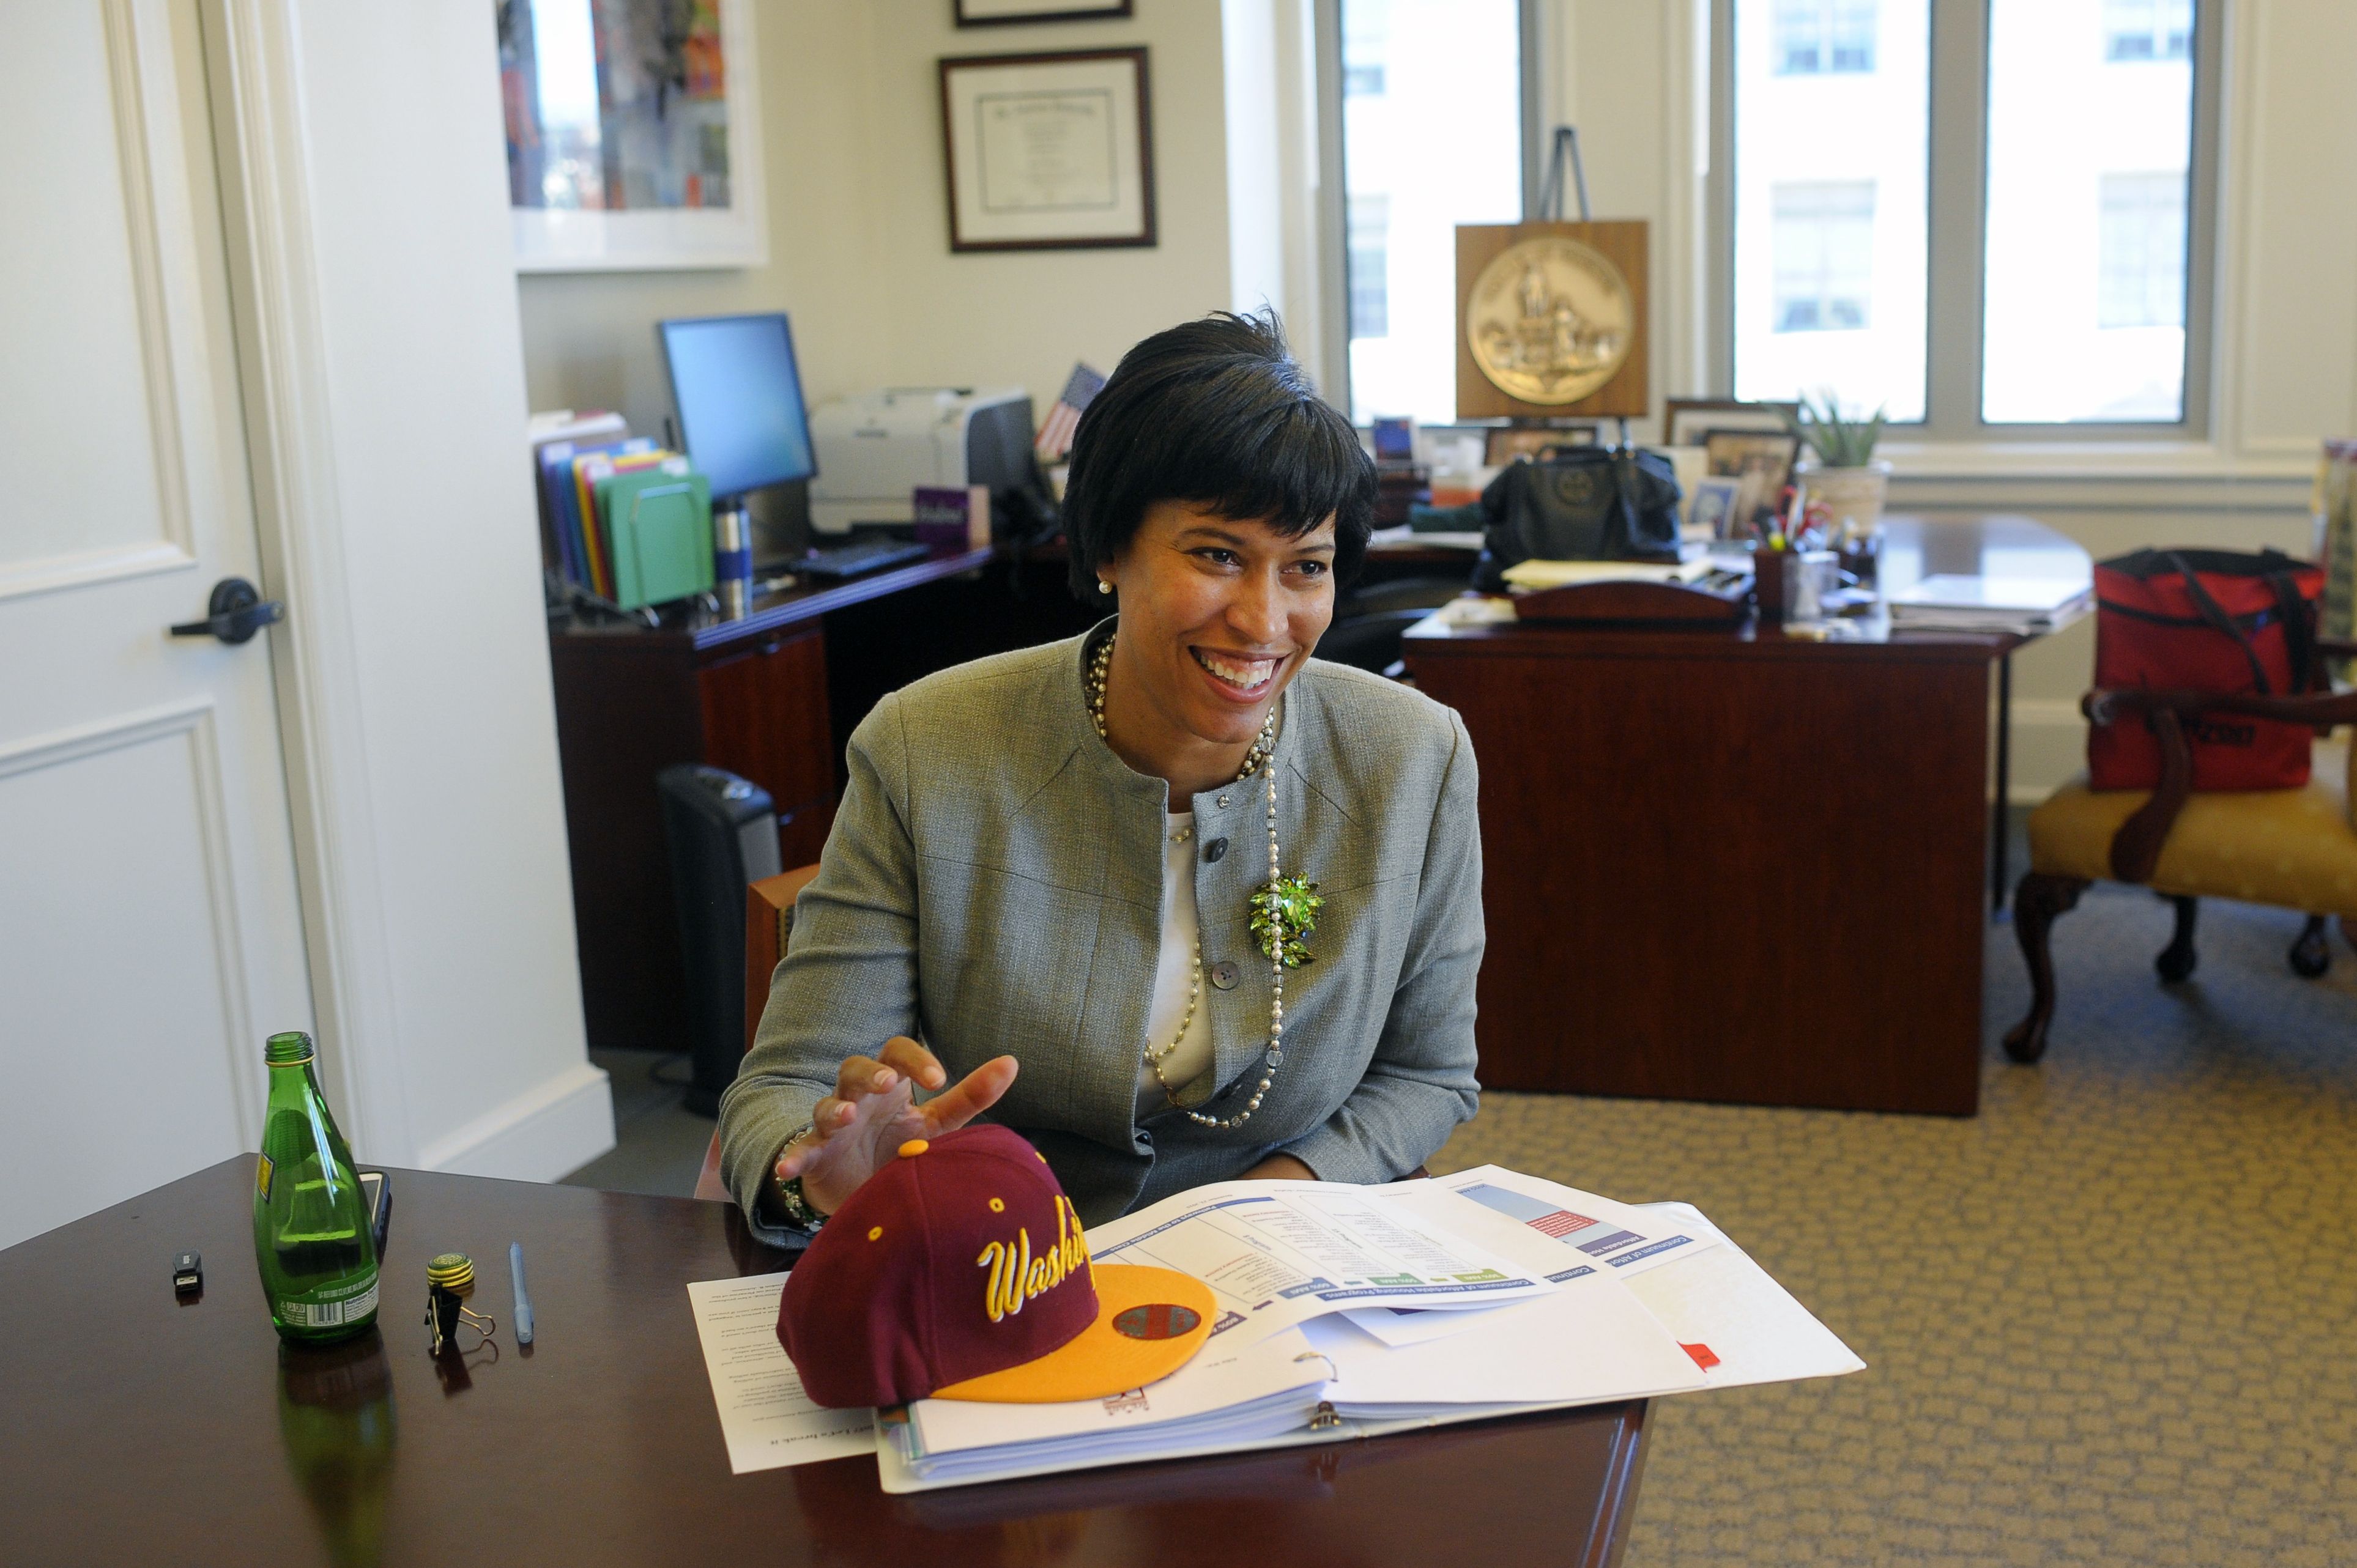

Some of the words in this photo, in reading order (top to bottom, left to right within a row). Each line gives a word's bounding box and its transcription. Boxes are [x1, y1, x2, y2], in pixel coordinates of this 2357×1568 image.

[1182, 1205, 1217, 1220] Pathways
[1132, 1229, 1158, 1243] Middle
[1110, 1241, 1130, 1251] Class
[1642, 1236, 1687, 1254] Continuum
[977, 1194, 1095, 1323] Washi
[1416, 1285, 1468, 1294] Affordable
[1478, 1279, 1529, 1290] Continuum
[346, 1293, 367, 1306] Nutrition
[1326, 1289, 1375, 1299] Programs
